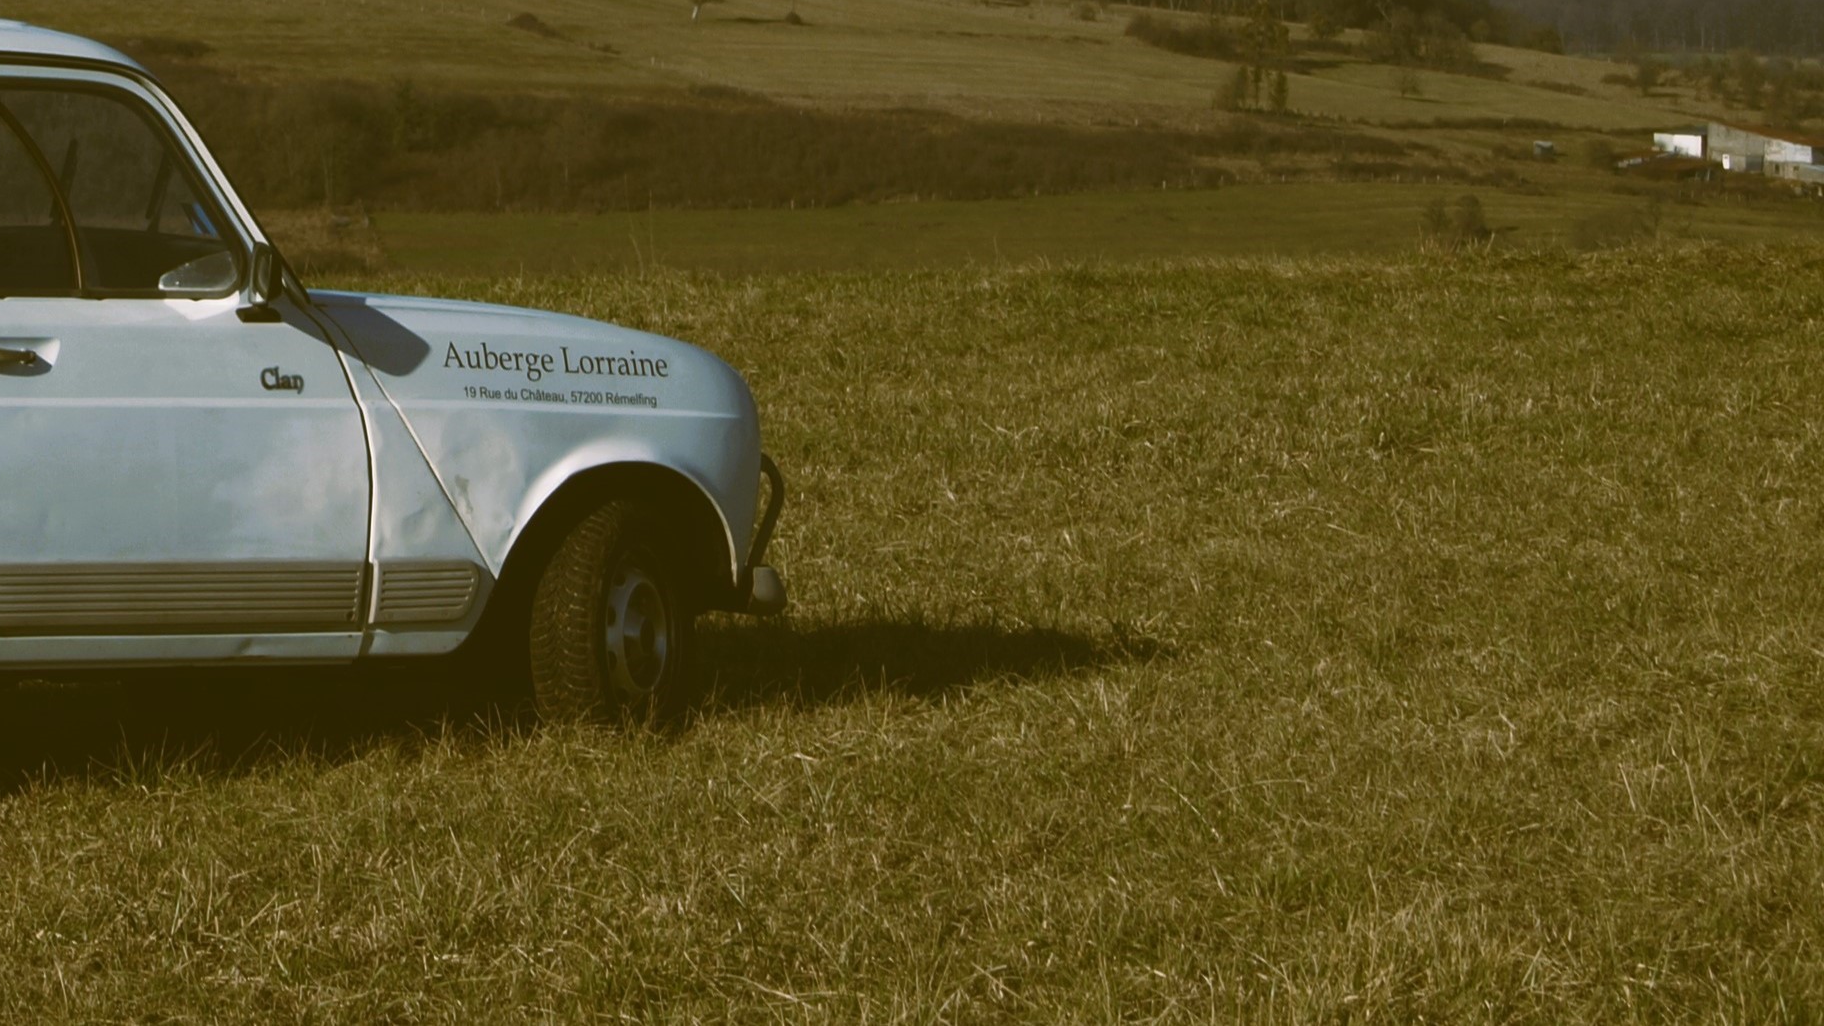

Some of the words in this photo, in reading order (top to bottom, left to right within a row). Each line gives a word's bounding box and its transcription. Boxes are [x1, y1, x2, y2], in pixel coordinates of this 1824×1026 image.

[443, 341, 555, 382] Auberge
[559, 345, 669, 378] Lorraine
[260, 365, 305, 395] Clan
[463, 386, 477, 399] 19
[479, 386, 502, 400] Rue
[504, 387, 519, 401] du
[520, 387, 569, 404] Château,
[570, 390, 604, 404] 57200
[606, 391, 658, 409] Rémelfing
